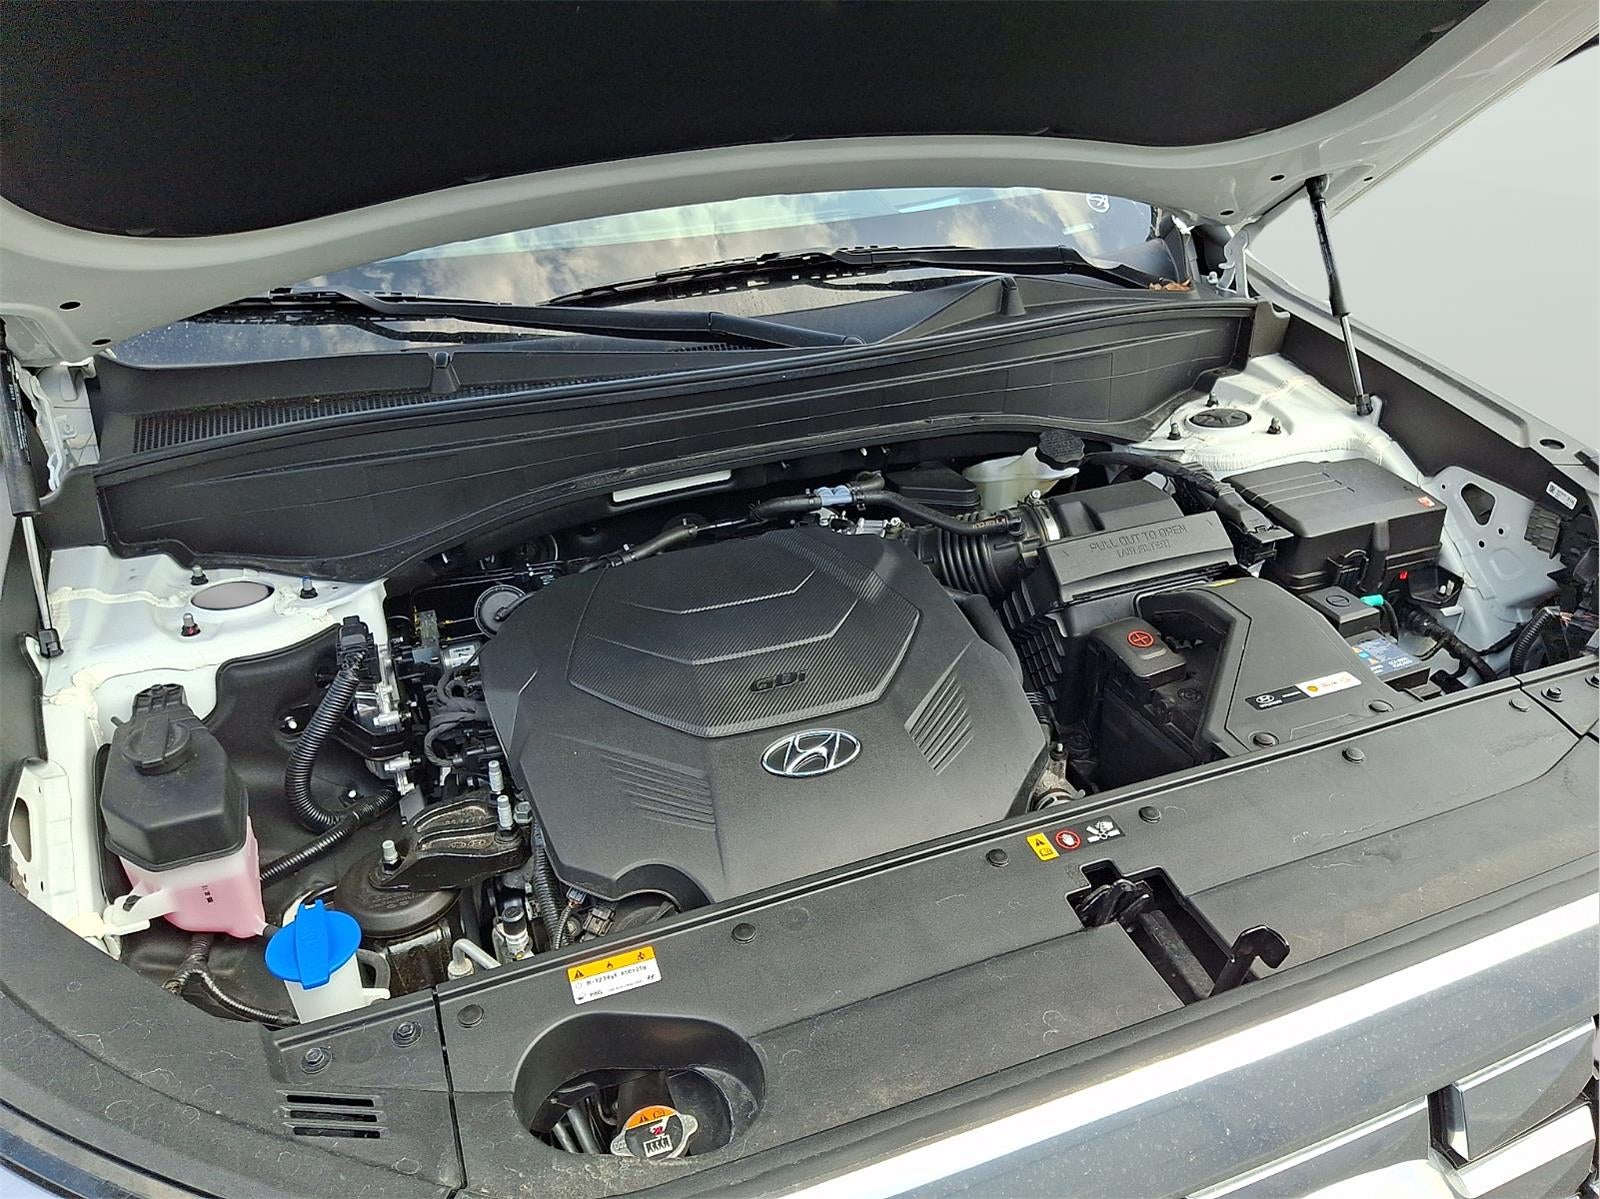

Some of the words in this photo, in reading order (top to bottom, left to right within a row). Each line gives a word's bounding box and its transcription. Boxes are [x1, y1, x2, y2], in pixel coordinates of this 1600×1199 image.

[1089, 538, 1118, 552] PULL
[1119, 534, 1141, 547] OUT
[1142, 530, 1157, 542] TO
[1158, 524, 1188, 538] OPEN
